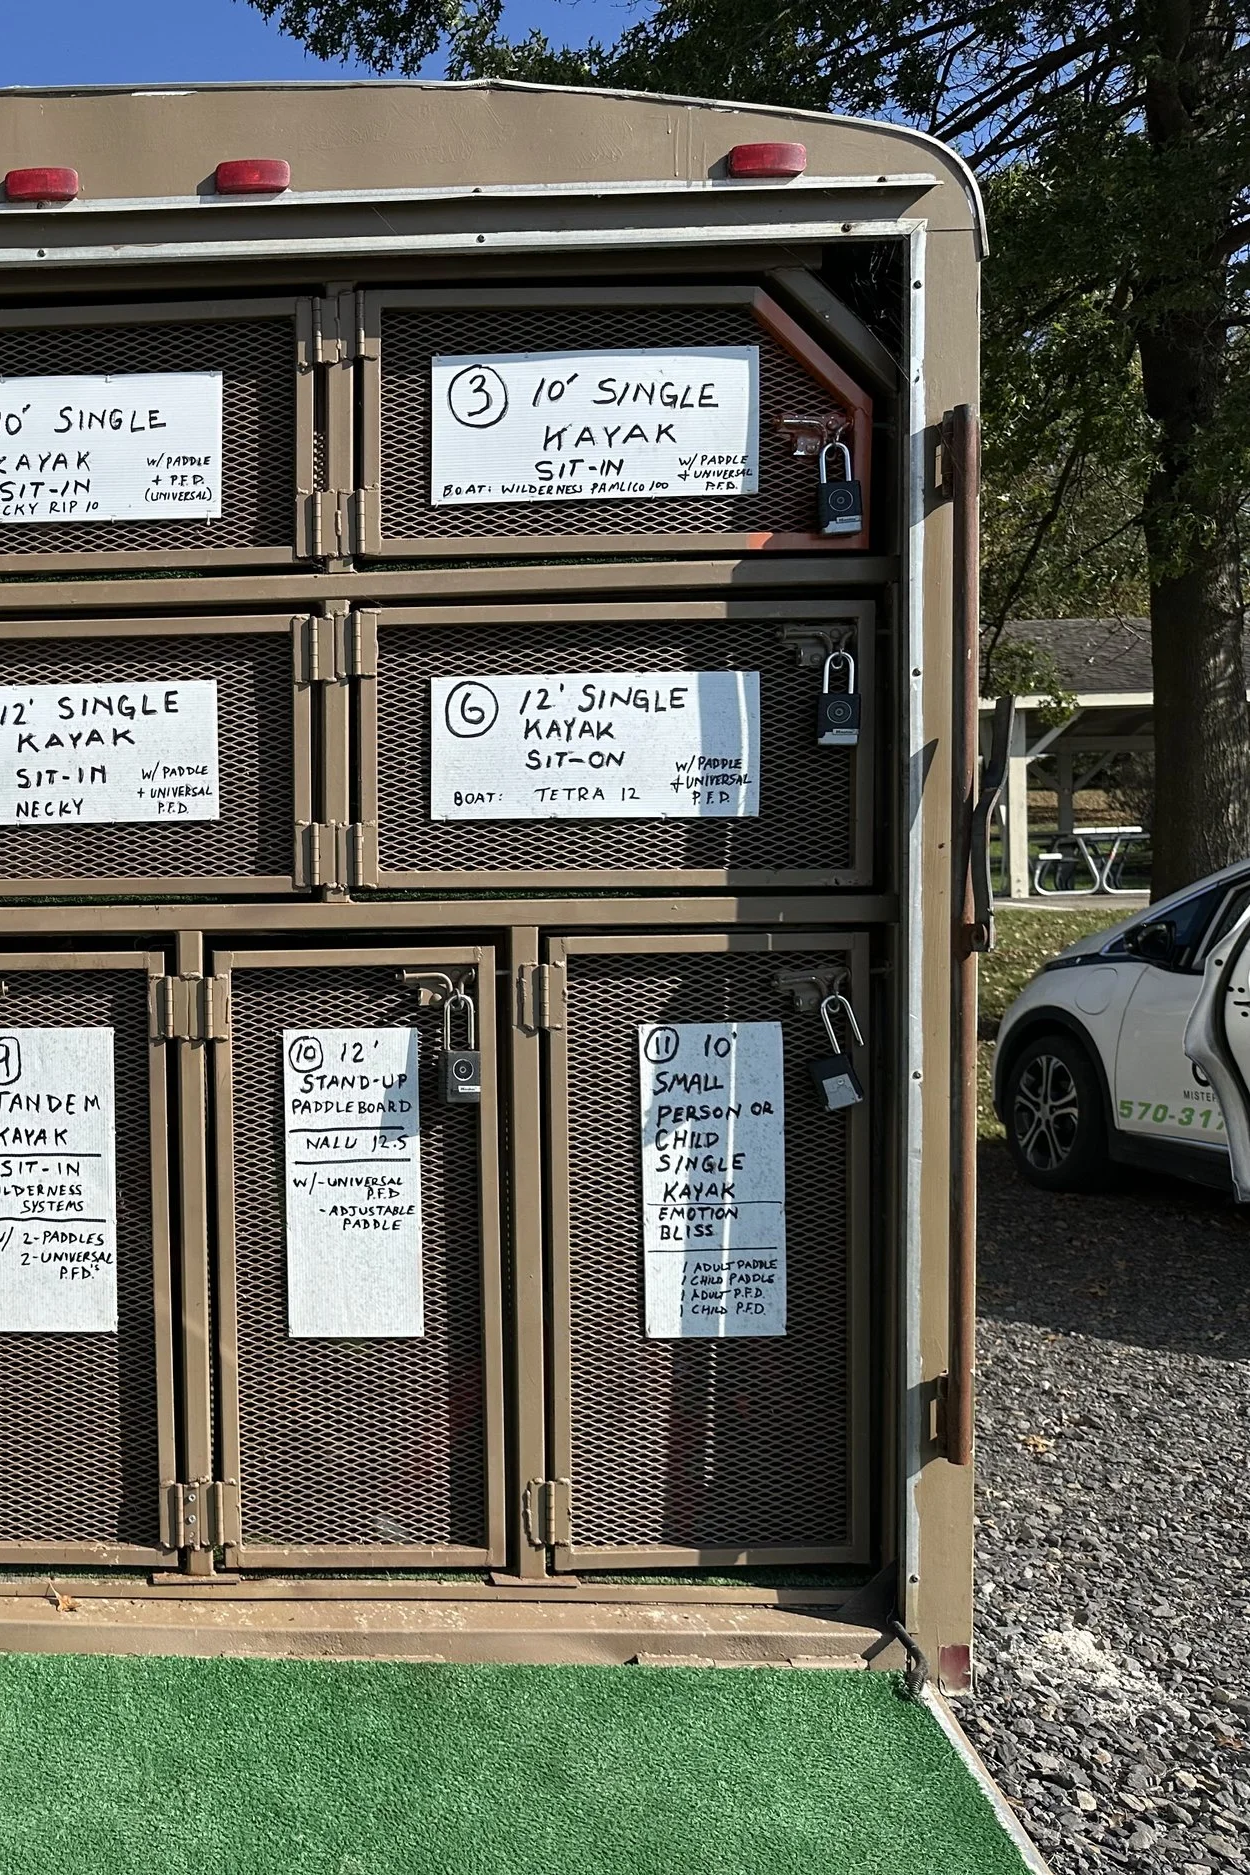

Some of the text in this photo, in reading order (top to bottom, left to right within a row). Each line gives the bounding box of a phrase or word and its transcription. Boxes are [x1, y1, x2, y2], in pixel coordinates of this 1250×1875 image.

[592, 377, 719, 409] SINGLE
[54, 406, 167, 434] SINGLE
[543, 423, 676, 452] KAYAK
[166, 455, 211, 467] PADDLE
[701, 455, 748, 465] PADDLE
[534, 458, 624, 481] SIT-IN
[694, 467, 753, 478] UNIVERSAL
[0, 478, 90, 501] SIT-IN
[144, 487, 212, 502] (UNIVERSAL)
[501, 483, 583, 495] WILDERNESS
[590, 481, 644, 494] PAMLICO
[649, 481, 669, 491] 100
[50, 501, 78, 513] RIP
[85, 501, 99, 512] 10
[58, 691, 179, 720] SINGLE
[578, 684, 689, 713] SINGLE
[524, 717, 615, 743] KAYAK
[18, 728, 136, 752] KAYAK
[525, 750, 626, 770] SIT-ON
[698, 757, 743, 770] PADDLE
[17, 765, 107, 789] SIT-IN
[163, 765, 209, 777] PADDLE
[686, 774, 753, 789] UNIVERSAL
[151, 786, 213, 799] UNIVERSAL
[534, 787, 606, 802] TETRA
[621, 787, 640, 800] 12
[16, 798, 84, 817] NECKY
[300, 1074, 408, 1094] STAND-UP
[653, 1071, 724, 1096] SMALL
[656, 1101, 774, 1128] PERSON OR
[307, 1135, 407, 1152] NALU 12.5
[655, 1129, 719, 1151] CHILD
[0, 1160, 81, 1178] SIT-IN
[656, 1153, 746, 1174] SINGLE
[663, 1181, 735, 1202] KAYAK
[20, 1200, 84, 1214] SYSTEMS
[658, 1207, 738, 1221] EMOTION
[343, 1218, 403, 1231] PADDLE
[661, 1224, 714, 1240] BLISS
[693, 1262, 735, 1274] ADULT
[737, 1259, 777, 1270] PADDLE
[690, 1276, 723, 1286] CHILD
[691, 1289, 731, 1301] ADULT
[691, 1304, 728, 1315] CHILD
